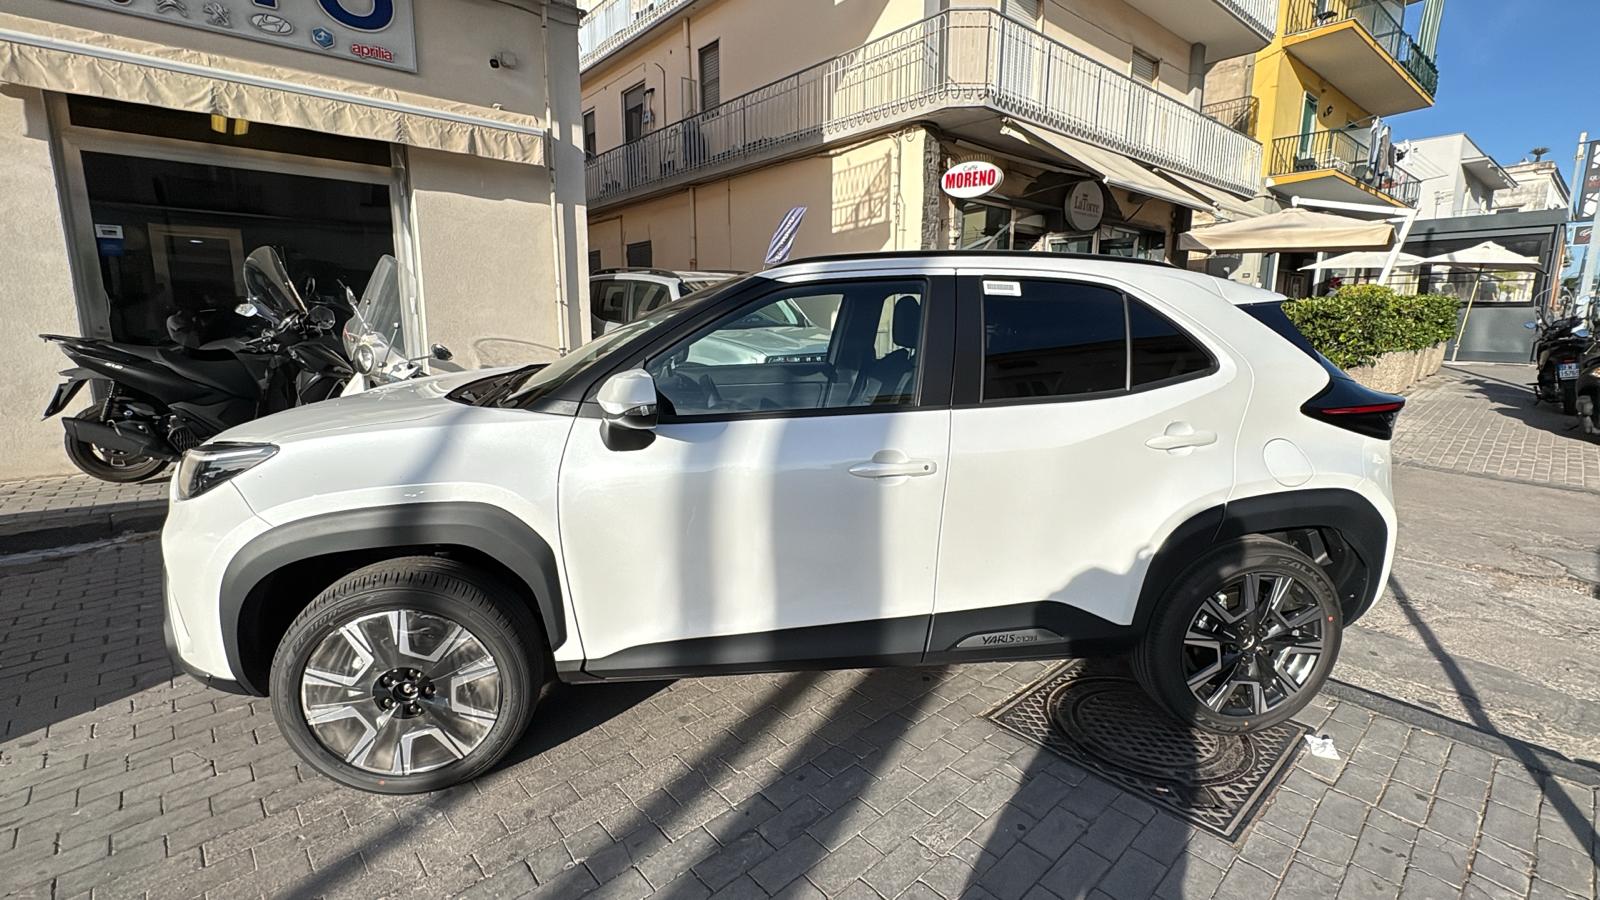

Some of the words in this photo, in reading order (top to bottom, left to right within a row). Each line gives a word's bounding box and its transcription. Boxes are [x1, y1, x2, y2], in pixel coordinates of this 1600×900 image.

[351, 42, 393, 62] aprilia
[945, 168, 996, 189] MORENO
[982, 634, 1015, 645] YARIS
